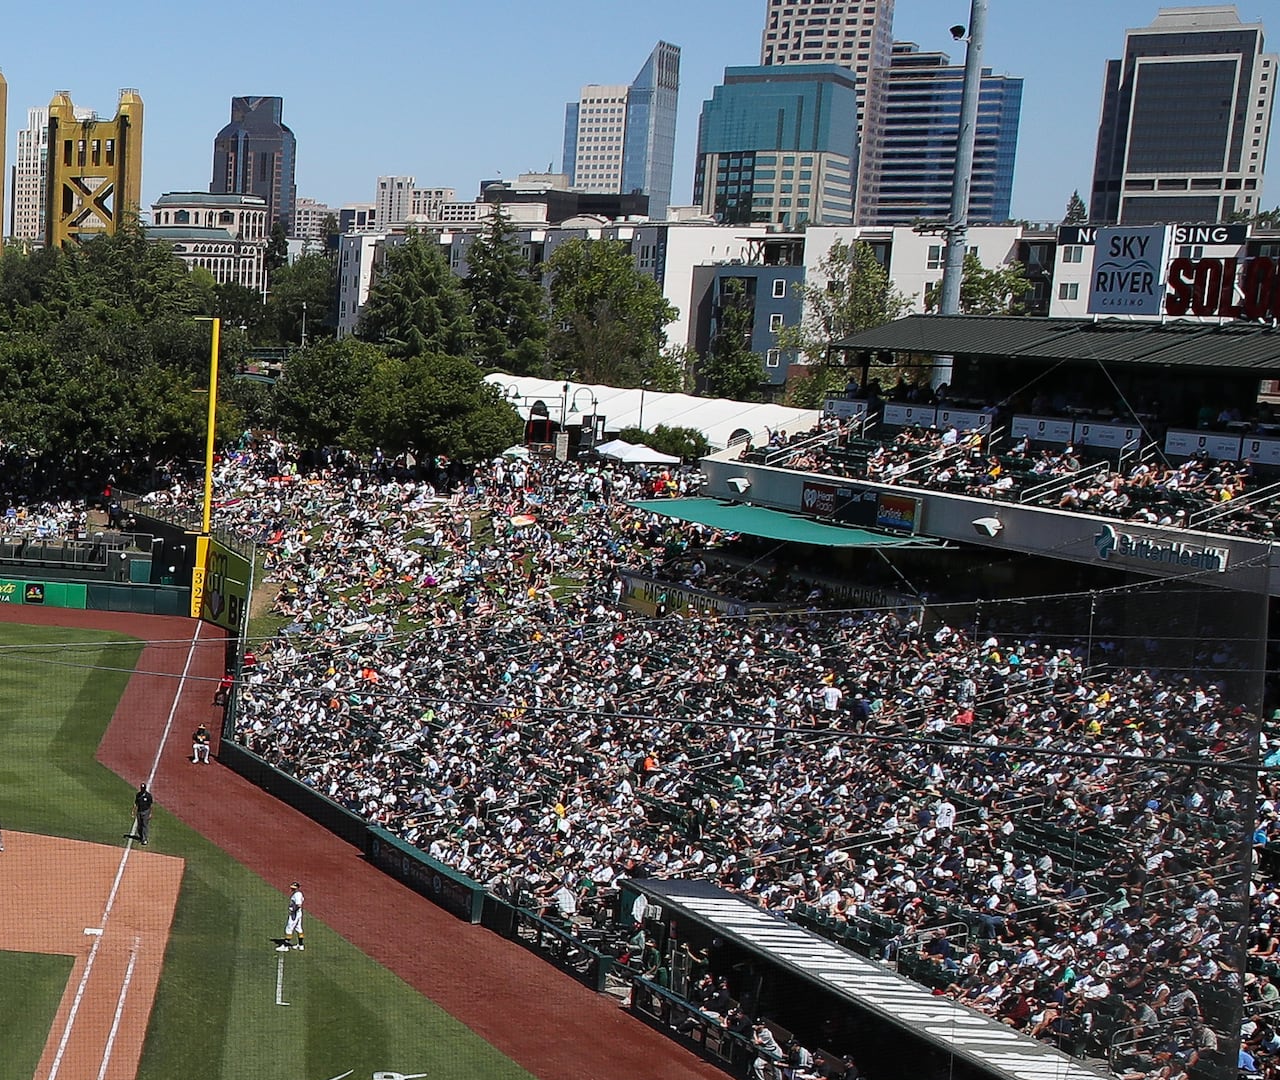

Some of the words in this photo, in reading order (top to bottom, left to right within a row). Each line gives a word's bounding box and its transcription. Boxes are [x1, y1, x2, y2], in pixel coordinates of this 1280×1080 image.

[1109, 236, 1150, 259] SKY
[1176, 228, 1228, 243] SING
[1095, 271, 1153, 296] RIVER
[1165, 257, 1280, 319] SOLO
[1102, 298, 1144, 306] CASINO
[1118, 534, 1171, 562] Sutter
[1171, 543, 1228, 573] Health
